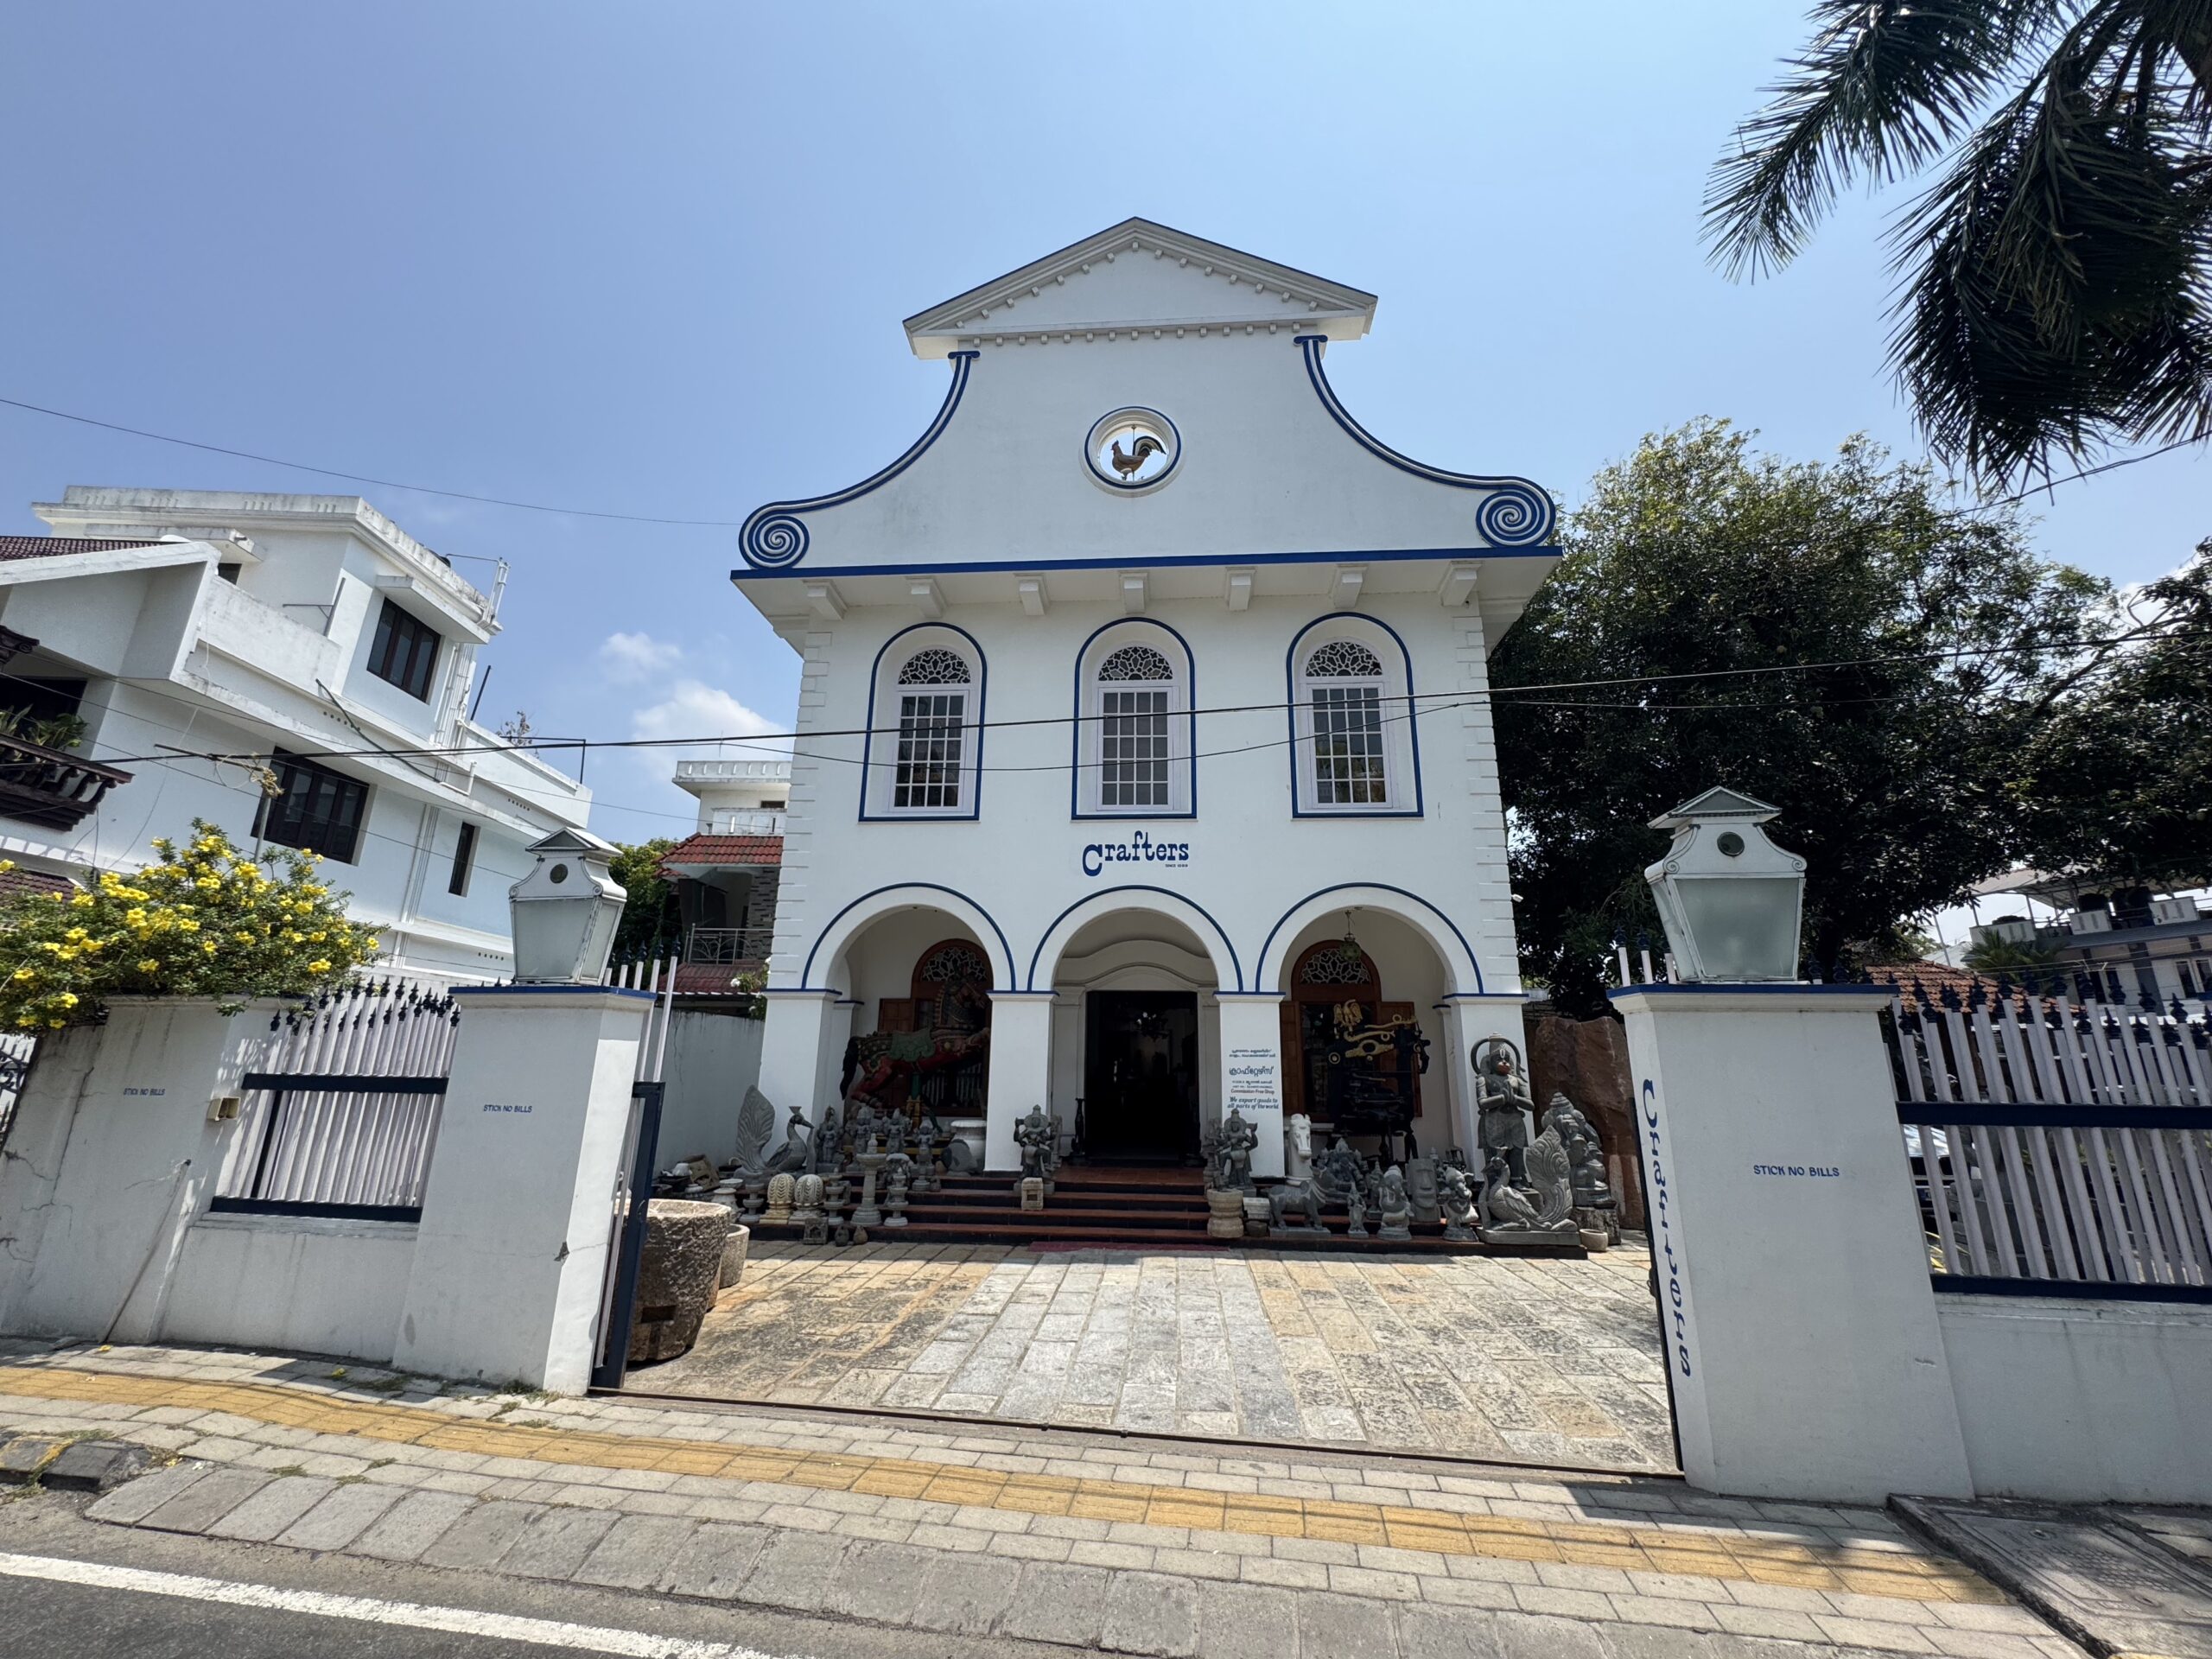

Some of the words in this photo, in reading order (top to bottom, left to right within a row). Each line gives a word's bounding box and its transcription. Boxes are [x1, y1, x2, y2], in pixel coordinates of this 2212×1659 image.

[1082, 830, 1189, 877] Crafters
[1753, 1165, 1786, 1175] STICK
[1788, 1166, 1805, 1176] NO
[1809, 1166, 1840, 1177] BILLS
[1643, 1078, 1691, 1377] Crafters
